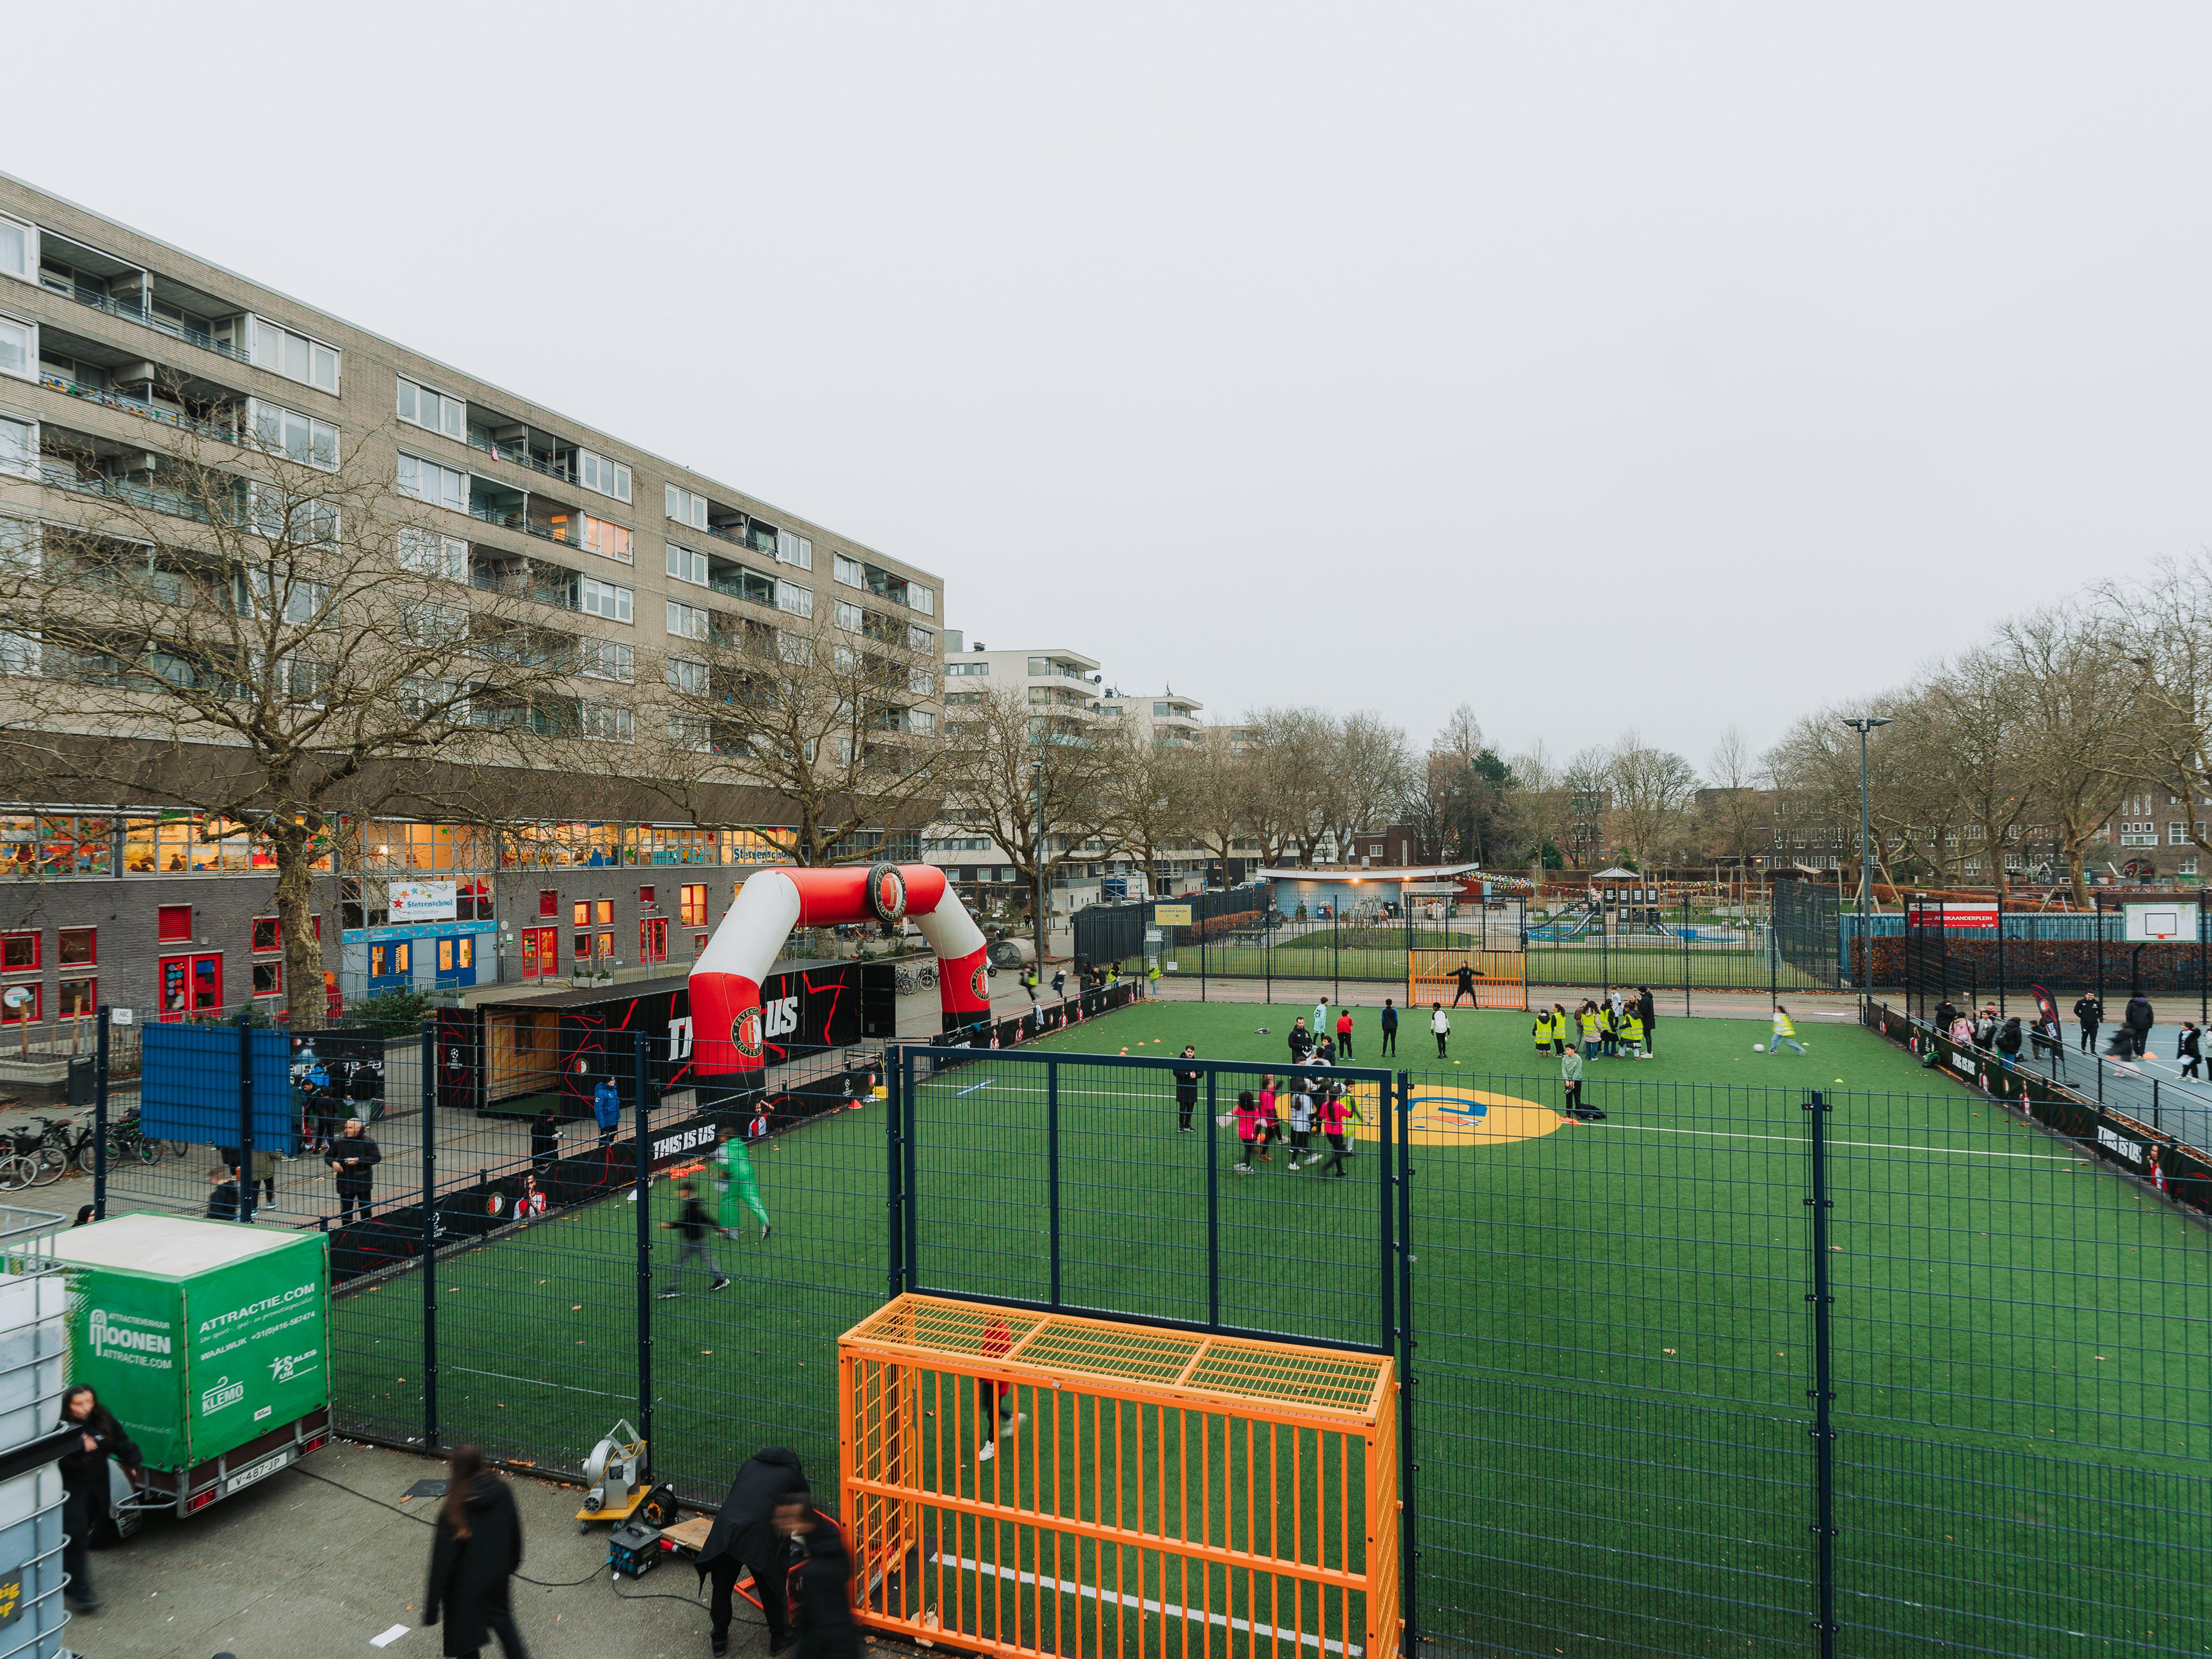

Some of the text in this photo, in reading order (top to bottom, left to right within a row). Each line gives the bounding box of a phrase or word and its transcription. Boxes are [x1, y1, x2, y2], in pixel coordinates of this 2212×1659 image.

[734, 848, 793, 860] Sterrenscho
[407, 899, 452, 907] Sterrenschool
[765, 996, 798, 1037] US
[653, 1124, 715, 1160] THIS IS US
[2097, 1125, 2142, 1164] THIS IS US
[108, 1312, 170, 1330] ATTRACTIEVERHUUR
[199, 1282, 315, 1334] ATTRACTIE.COM
[200, 1310, 316, 1361] WAALWIJK +31(0)416-567474
[103, 1348, 172, 1369] ATTRACTIE.COM
[203, 1384, 244, 1413] KLEMO
[236, 1457, 280, 1486] V-487-JP
